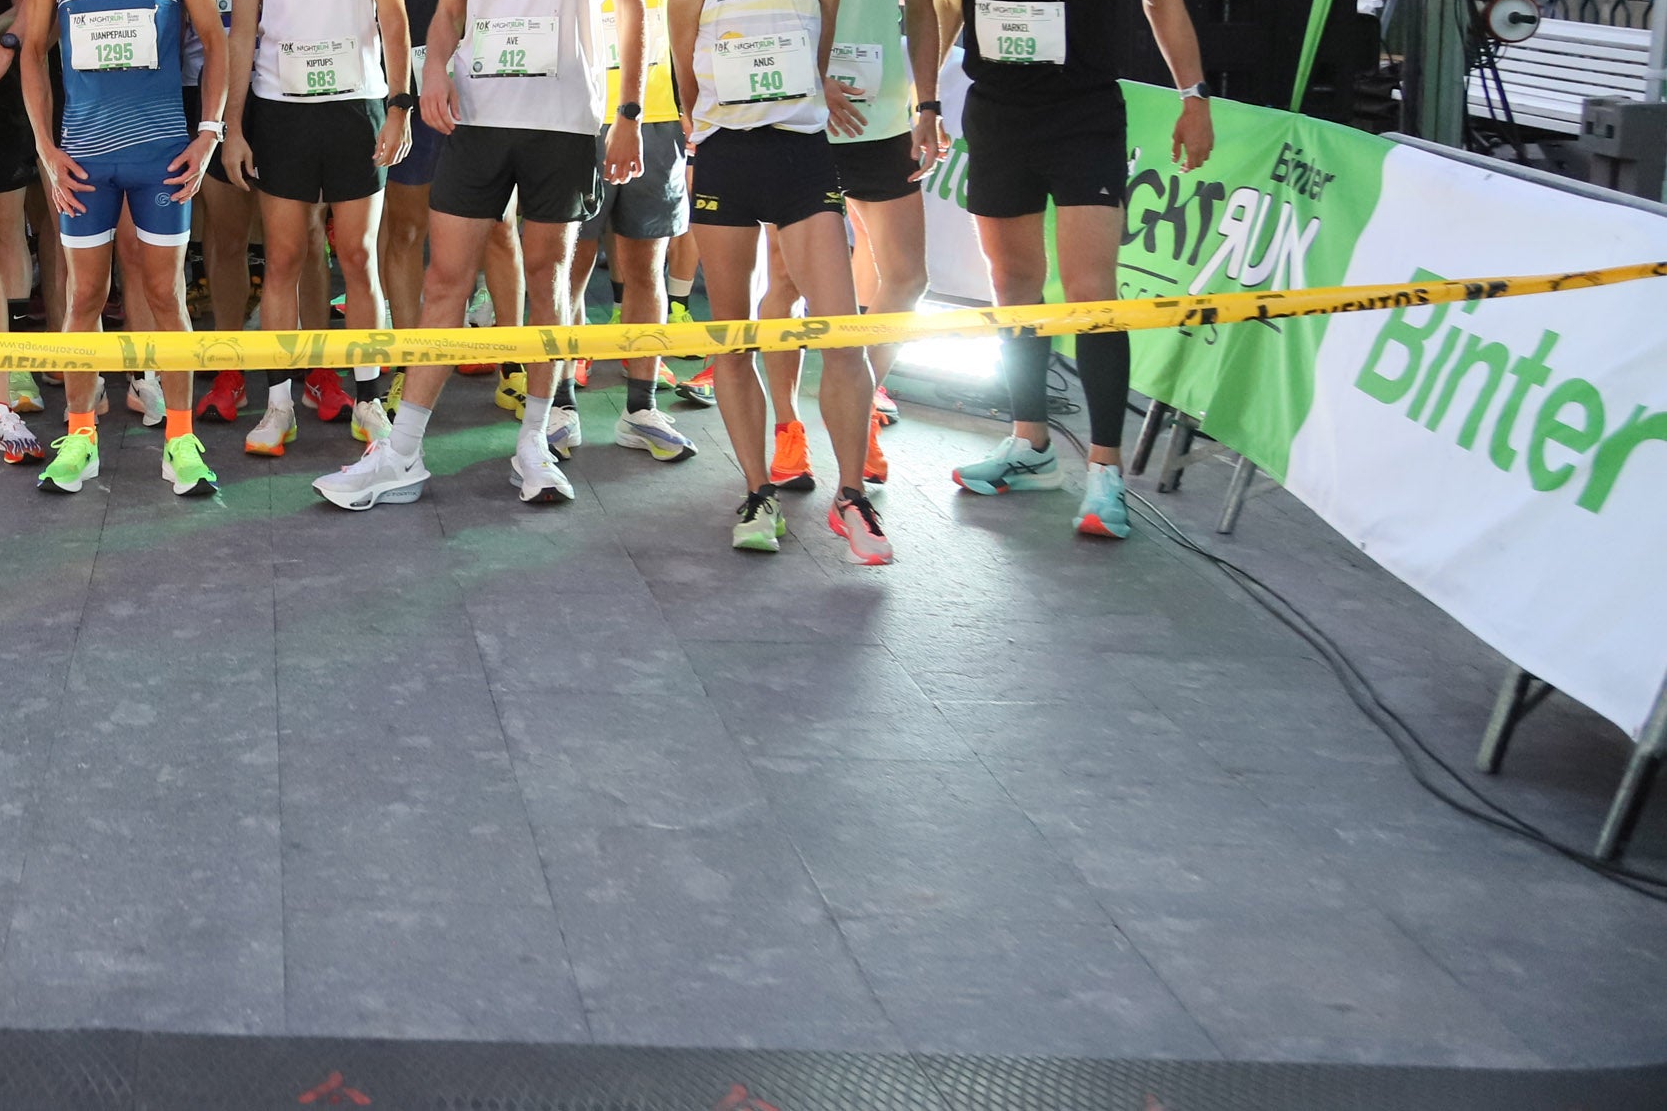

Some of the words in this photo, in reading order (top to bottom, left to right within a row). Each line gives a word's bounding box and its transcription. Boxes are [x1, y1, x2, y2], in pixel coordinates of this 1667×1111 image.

[1001, 22, 1030, 32] MARKEL
[506, 36, 519, 45] AVE
[997, 36, 1036, 55] 1269
[95, 42, 134, 62] 1295
[498, 49, 526, 67] 412
[306, 58, 333, 67] KIPTUPS
[306, 70, 336, 87] 683
[749, 70, 783, 92] F40
[1354, 267, 1667, 515] Binter
